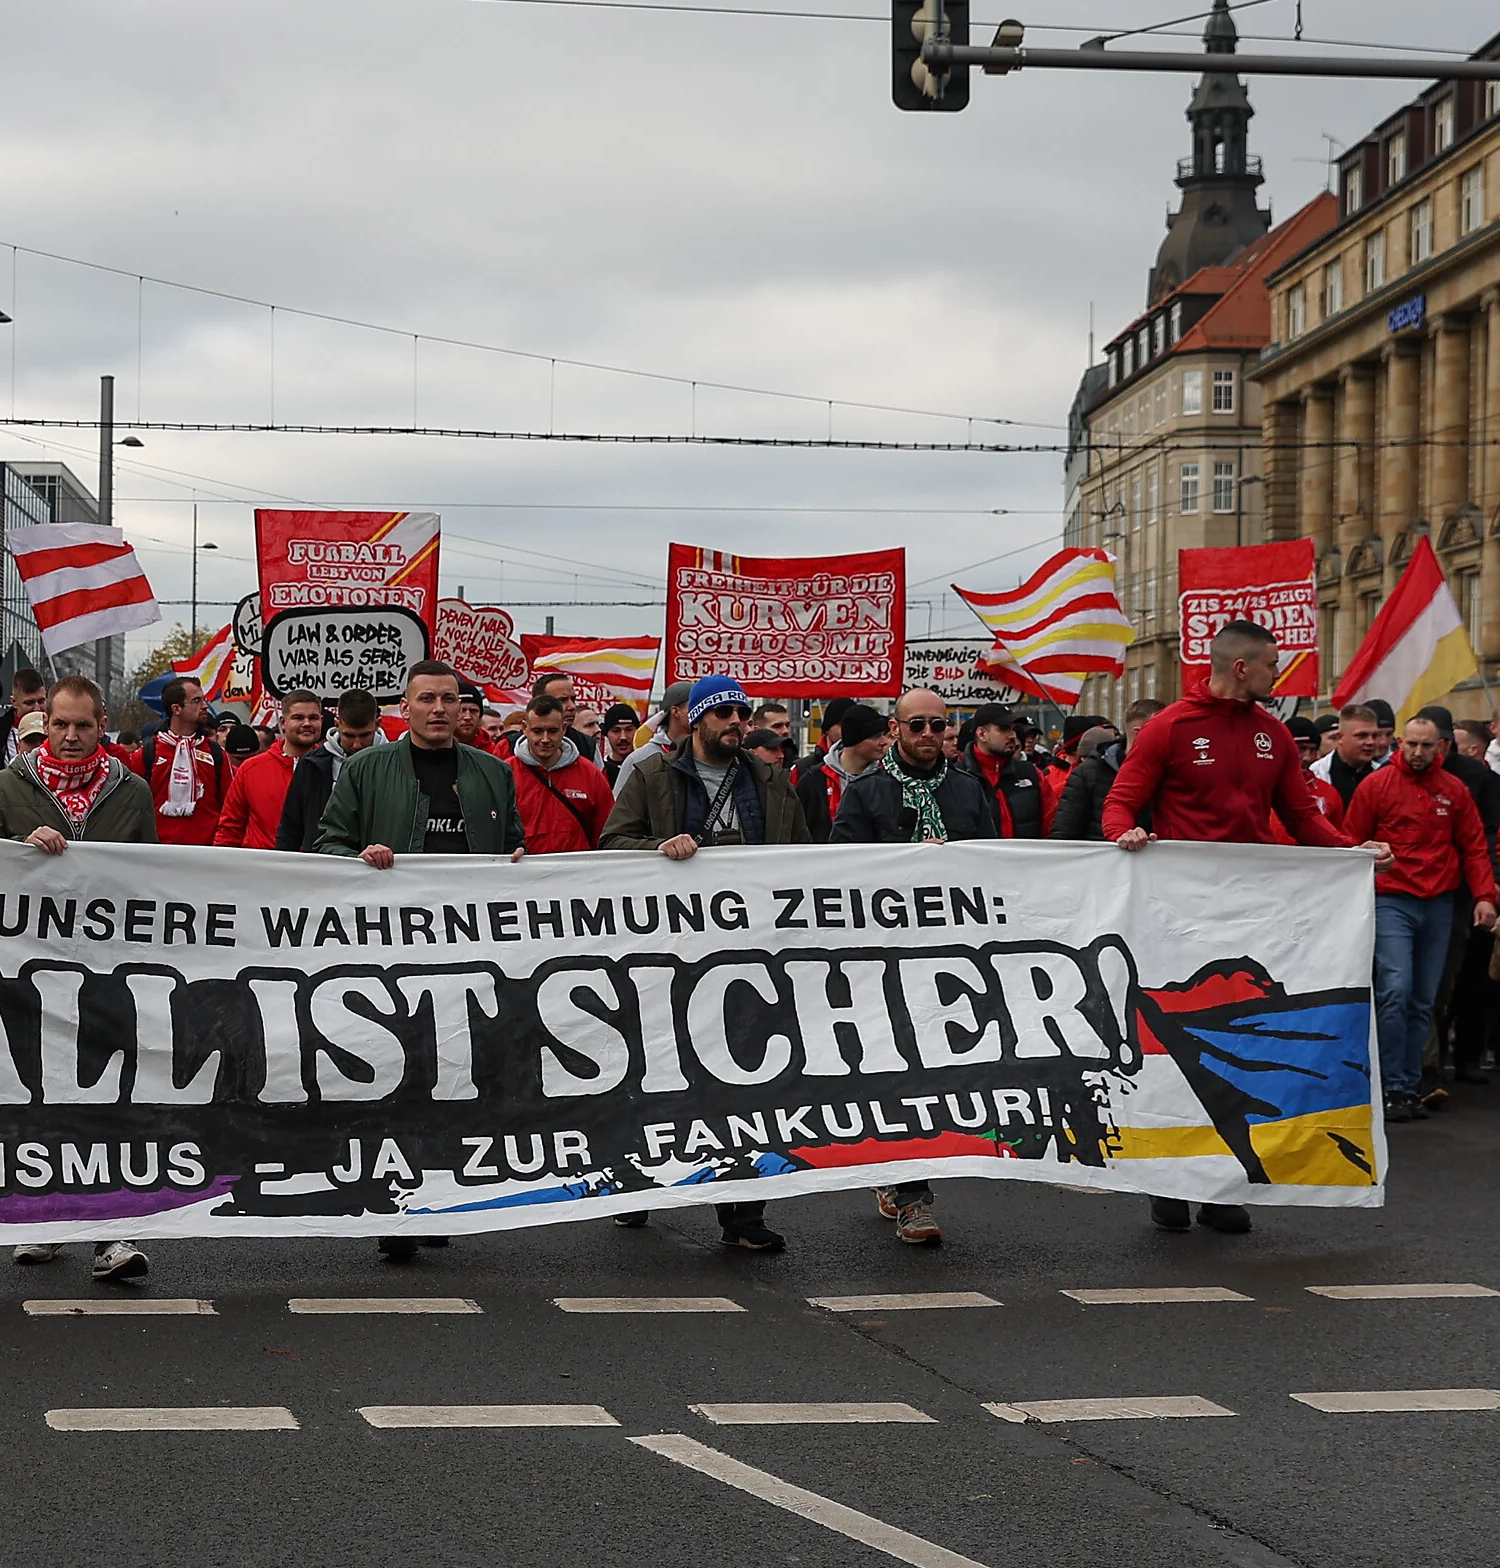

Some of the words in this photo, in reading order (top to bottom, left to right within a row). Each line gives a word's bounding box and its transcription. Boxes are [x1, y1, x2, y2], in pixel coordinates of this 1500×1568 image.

[310, 565, 348, 578] LEBT
[351, 567, 385, 581] VON
[679, 569, 792, 596] FREIHEIT
[795, 572, 846, 596] FÜR
[850, 574, 892, 594] DIE
[272, 585, 424, 611] EMOTIONEN
[1186, 598, 1221, 614] ZIS
[1223, 595, 1268, 612] 24/25
[1269, 588, 1312, 606] ZEIGT
[437, 607, 479, 630] DENEN
[480, 615, 507, 636] WAR
[679, 592, 891, 632] KURVEN
[287, 621, 322, 646] LAW
[325, 623, 340, 644] &
[341, 622, 403, 647] ORDER
[435, 638, 450, 650] ND
[445, 627, 480, 648] NOCH
[677, 630, 825, 654] SCHLUSS
[829, 631, 891, 656] MIT
[278, 648, 319, 670] WAR
[324, 646, 354, 667] ALS
[676, 658, 890, 681] REPRESSIONEN!
[277, 670, 327, 692] SCHON
[967, 667, 997, 681] UNTE
[703, 800, 722, 831] UNDER
[717, 766, 739, 804] ARMOUR
[259, 889, 750, 948] WAHRNEHMUNG
[772, 885, 1007, 930] ZEIGEN:
[248, 970, 499, 1104] IST
[536, 944, 1134, 1099] SICHER!
[331, 1137, 414, 1184] JA
[461, 1129, 592, 1177] ZUR
[642, 1086, 1053, 1160] FANKULTUR!
